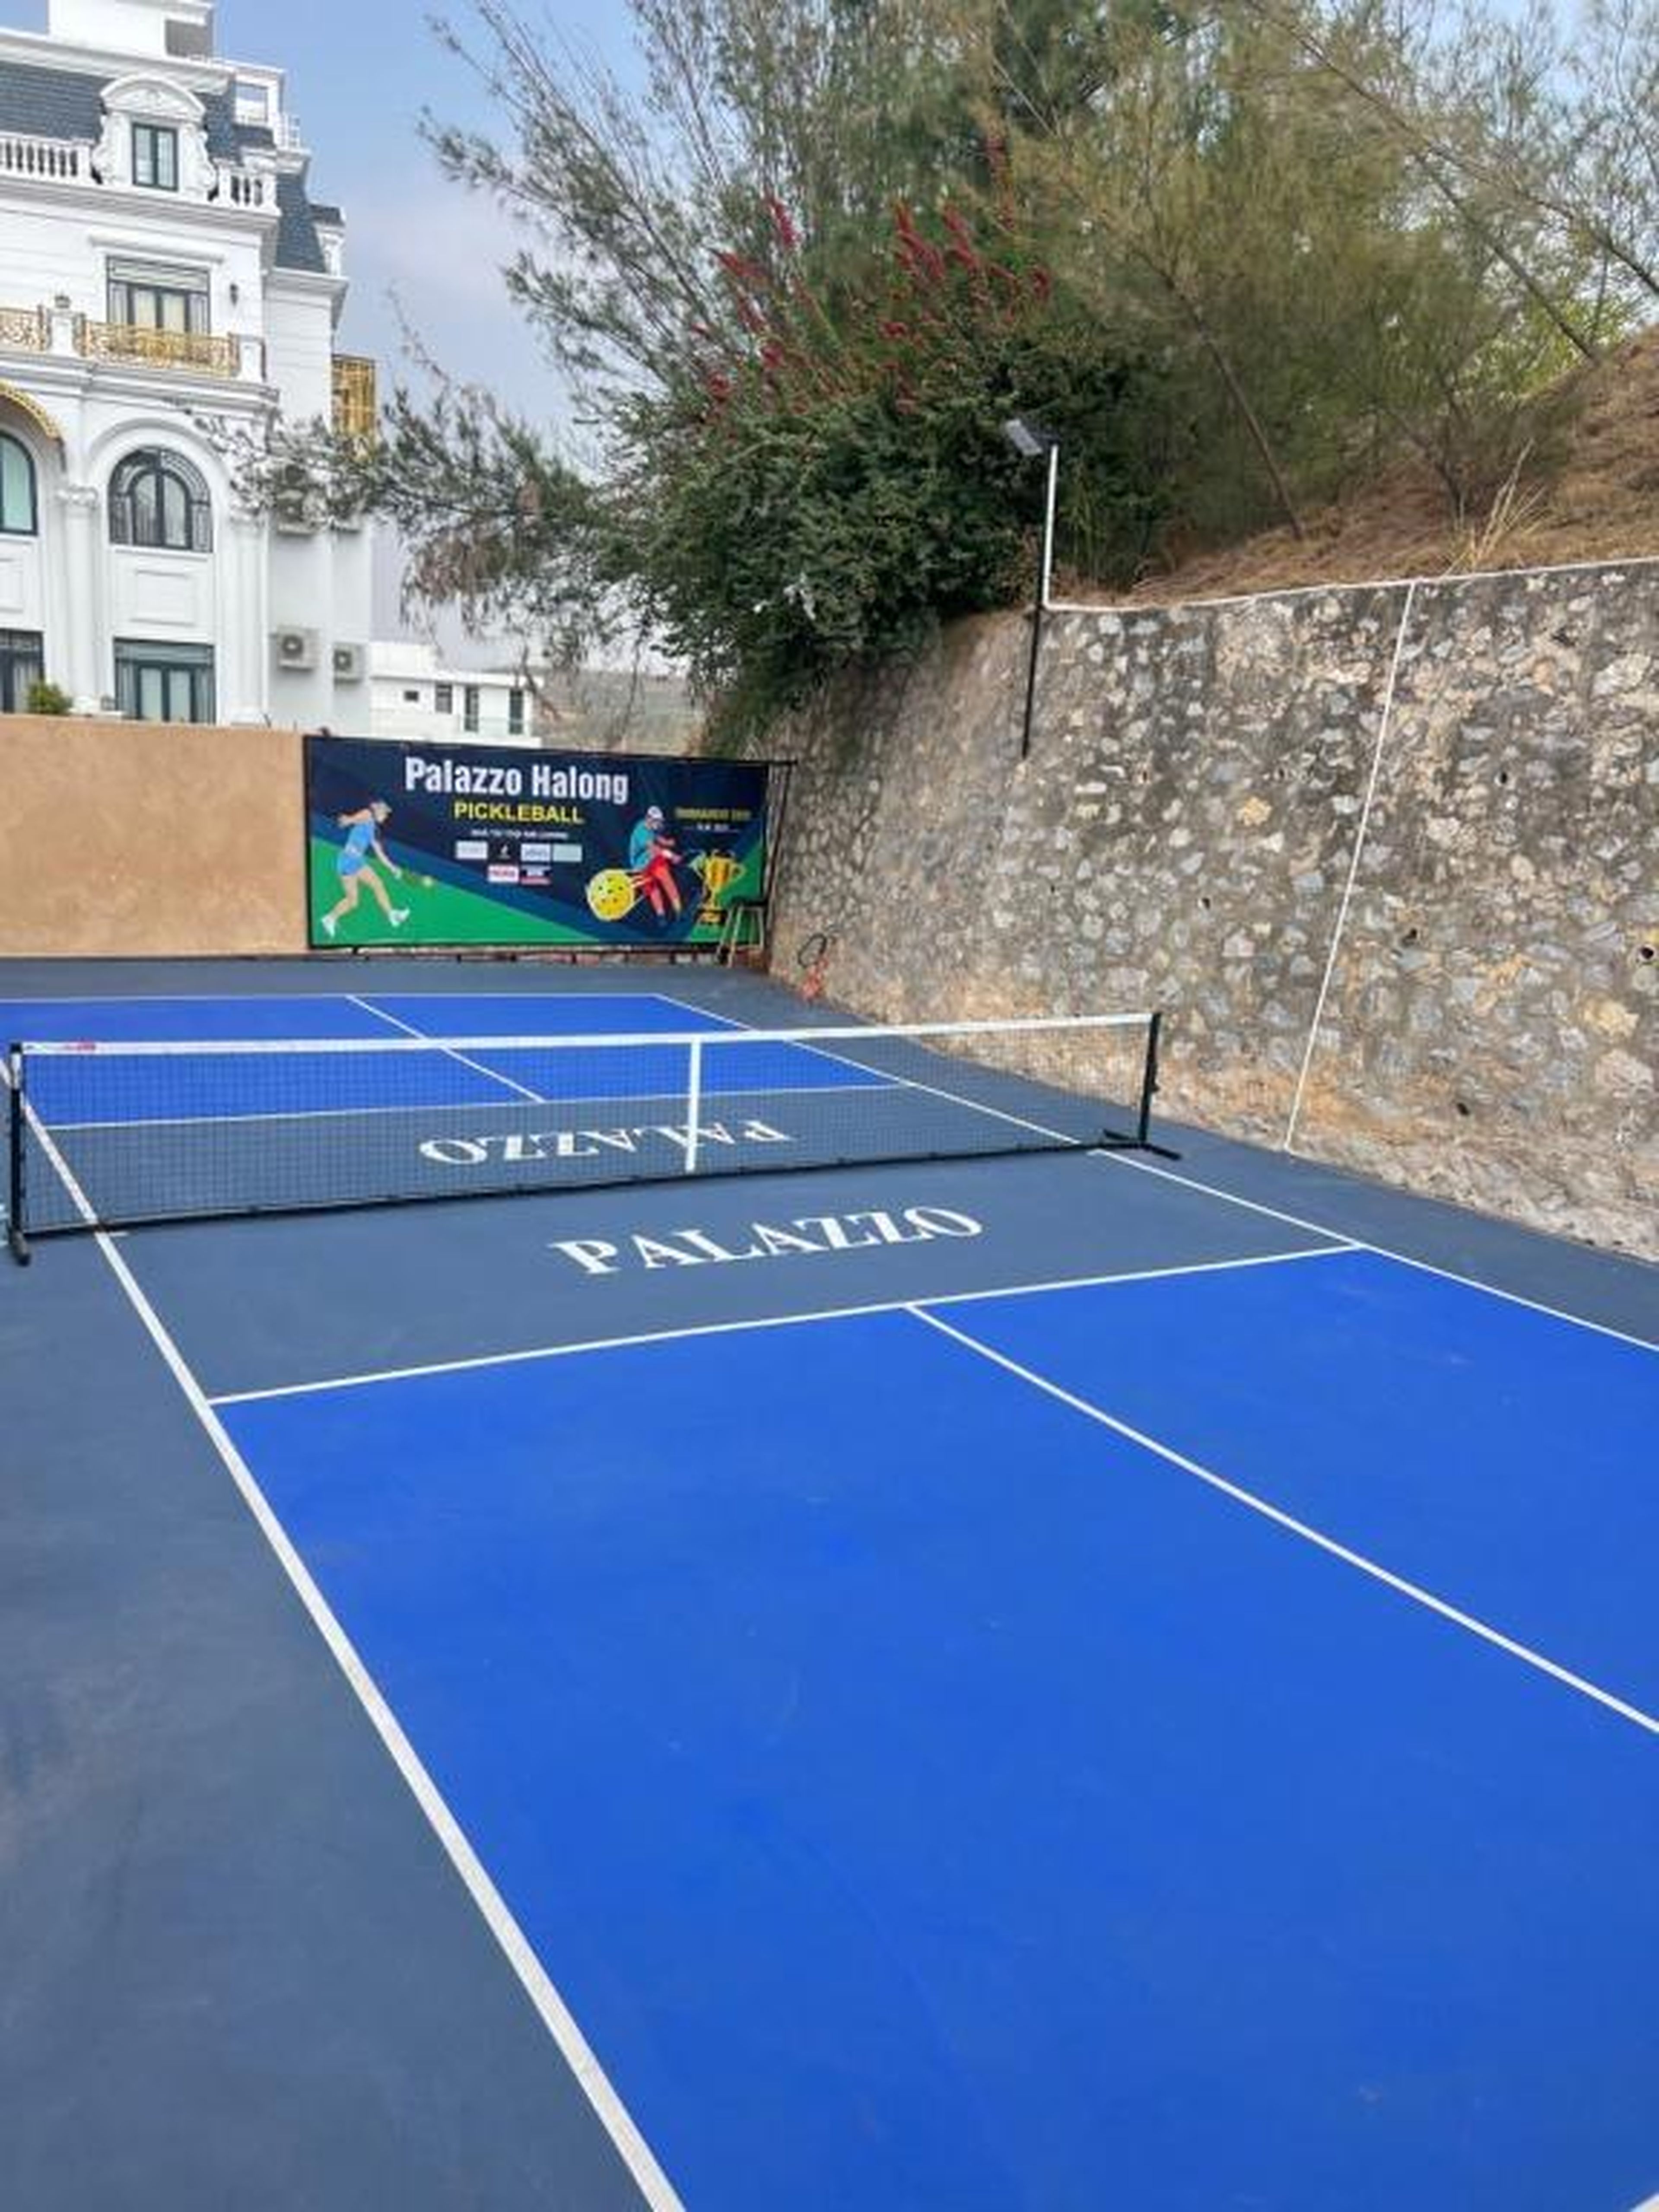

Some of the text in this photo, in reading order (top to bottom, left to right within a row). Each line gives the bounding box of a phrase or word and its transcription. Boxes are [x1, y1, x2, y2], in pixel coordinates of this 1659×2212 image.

[405, 756, 629, 804] Palazzo Halong
[454, 801, 585, 824] PICKLEBALL
[419, 1119, 794, 1165] PALAZZO
[548, 1206, 983, 1274] PALAZZO
